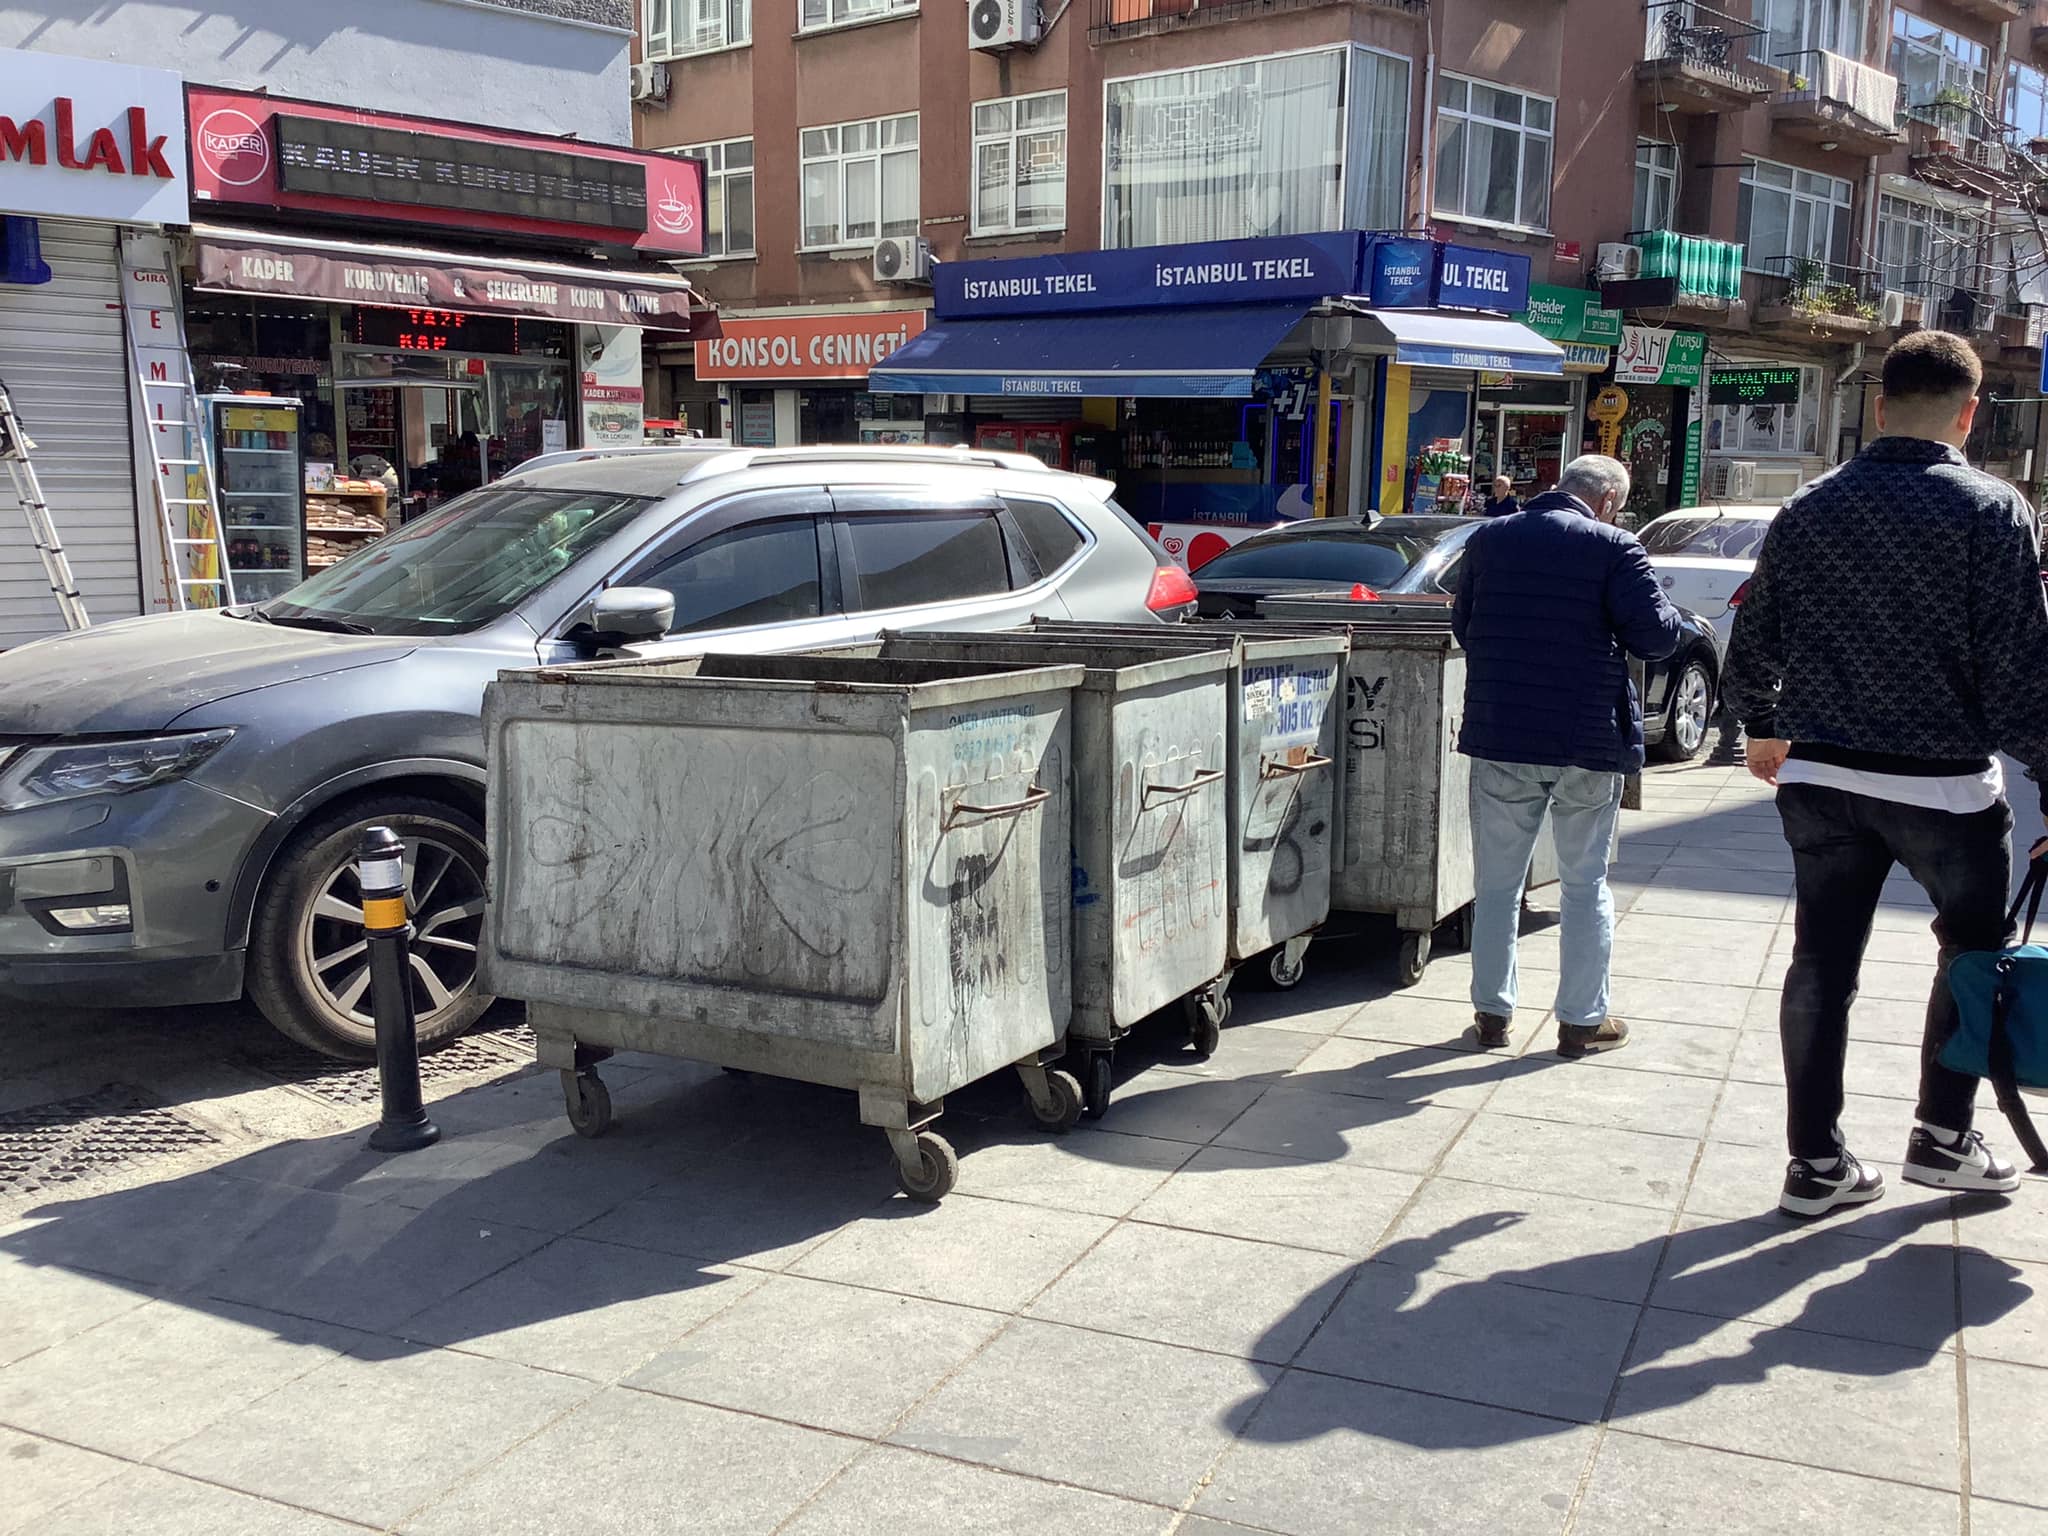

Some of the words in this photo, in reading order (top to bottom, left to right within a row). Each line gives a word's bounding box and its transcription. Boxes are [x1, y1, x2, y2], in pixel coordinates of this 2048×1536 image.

[207, 134, 260, 151] KADER
[1155, 263, 1247, 287] İSTANBUL
[1252, 258, 1314, 281] TEKEL
[1384, 265, 1422, 276] İSTANBUL
[1390, 276, 1413, 286] TEKEL
[1465, 265, 1510, 292] TEKEL
[241, 256, 294, 282] KADER
[454, 278, 465, 298] &
[486, 279, 558, 304] ŞEKERLEME
[570, 288, 605, 309] KURU
[619, 293, 661, 314] KAHVE
[964, 278, 1041, 300] İSTANBUL
[1045, 273, 1097, 294] TEKEL
[1527, 296, 1566, 315] hneider
[708, 335, 802, 367] KONSOL
[808, 323, 907, 366] CENNETİ
[1452, 348, 1488, 367] İSTANBUL
[1489, 355, 1512, 368] TEKEL
[1001, 377, 1050, 393] İSTANBUL
[1051, 381, 1083, 393] TEKEL
[1273, 383, 1307, 420] +1
[1297, 669, 1330, 696] METAL
